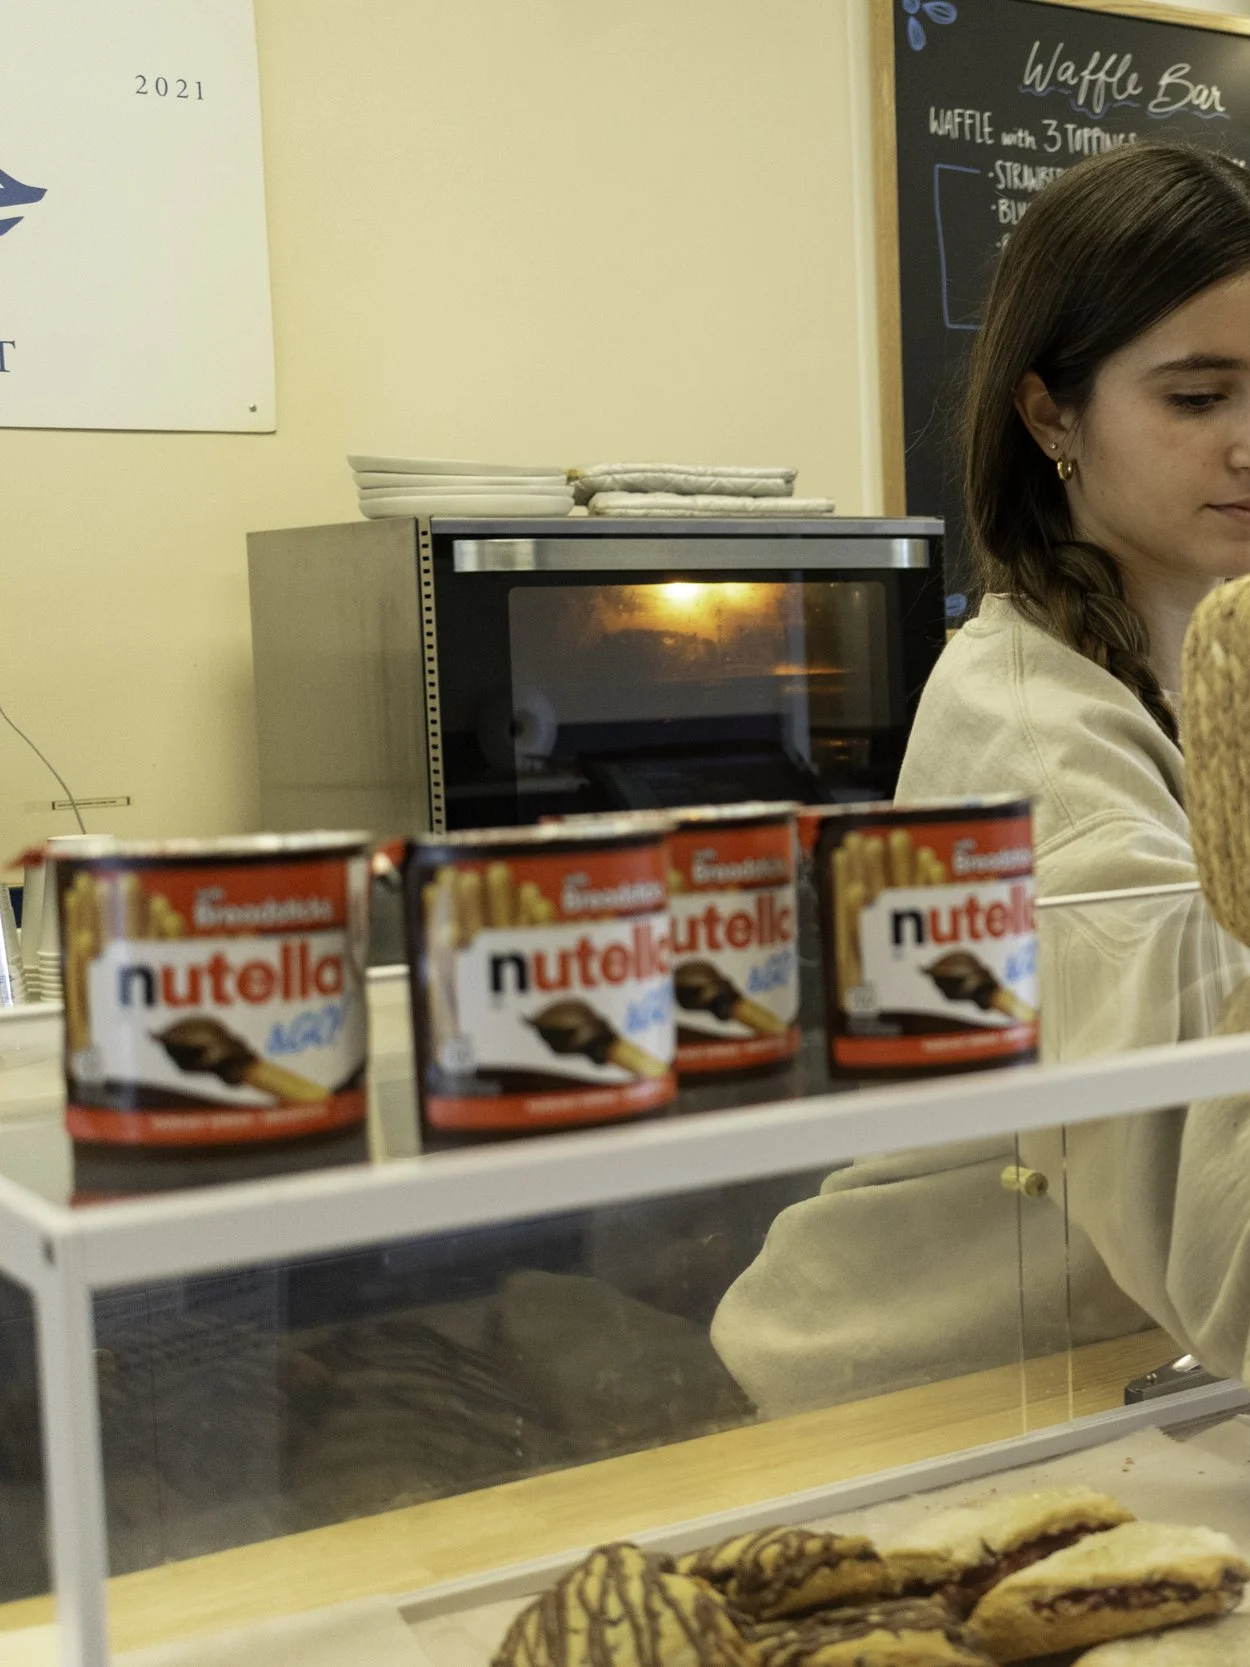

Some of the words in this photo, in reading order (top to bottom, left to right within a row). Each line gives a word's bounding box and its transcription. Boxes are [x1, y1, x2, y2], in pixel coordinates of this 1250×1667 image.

[135, 75, 205, 100] 2021
[1022, 41, 1143, 112] Waffle
[1147, 63, 1227, 112] Bar
[929, 106, 995, 145] WAFFLE
[1001, 127, 1037, 149] with
[1041, 119, 1062, 152] 3
[117, 939, 343, 1008] nutella
